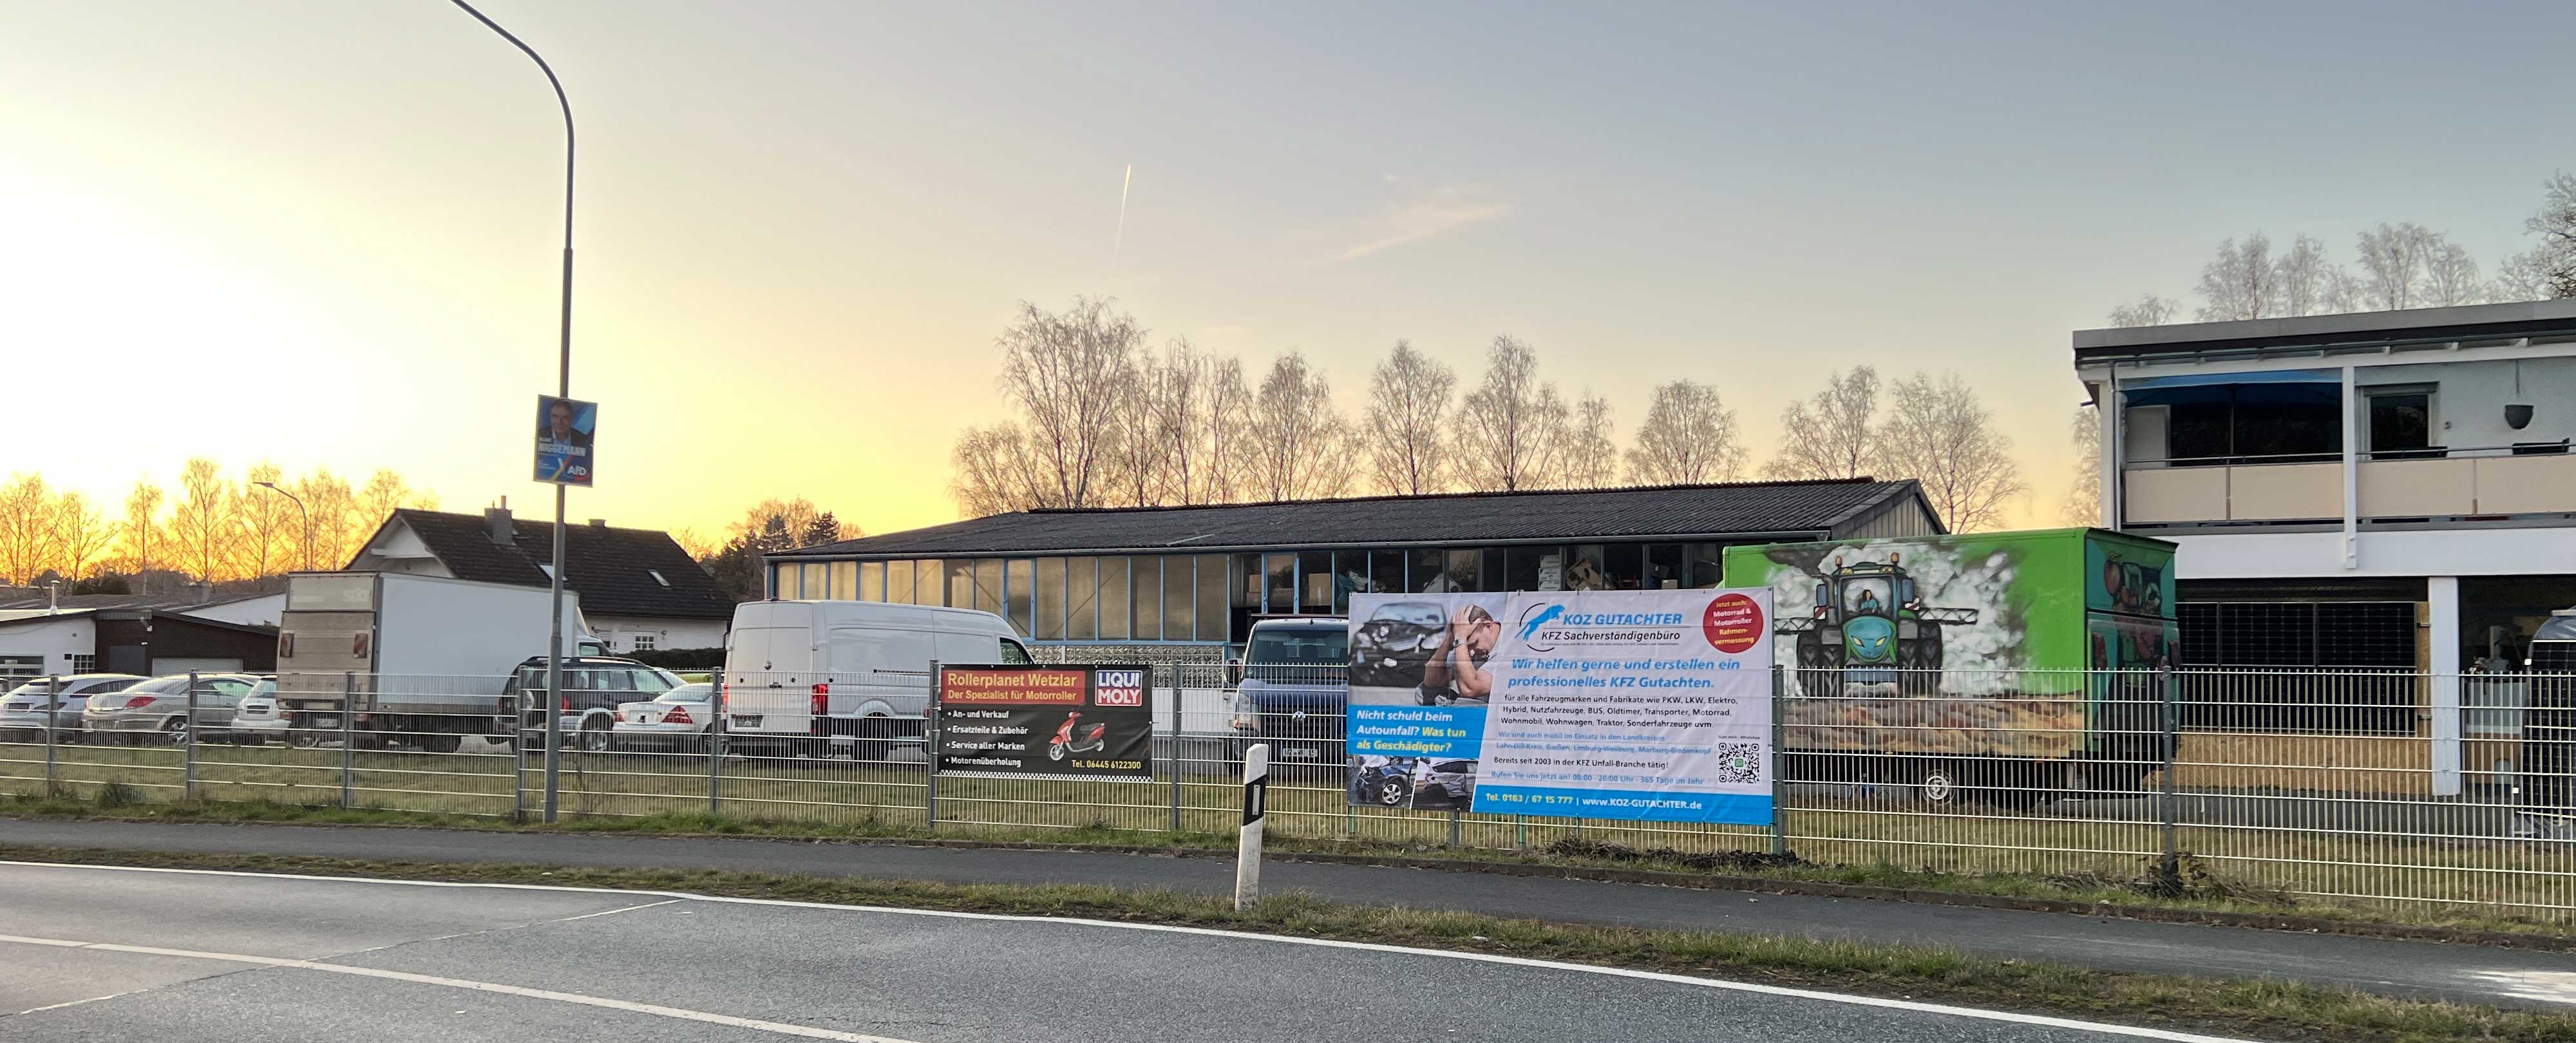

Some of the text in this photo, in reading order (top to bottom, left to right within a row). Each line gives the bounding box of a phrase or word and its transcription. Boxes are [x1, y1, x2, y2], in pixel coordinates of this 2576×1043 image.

[1713, 608, 1745, 617] Motorrad
[1563, 614, 1682, 625] KOZ GUTACHTER
[1714, 618, 1752, 626] Motorroller
[1542, 630, 1680, 642] KFZ Sachverständigenbüro
[1714, 637, 1754, 645] vermessung
[1513, 659, 1740, 672] Wir helfen gerne und erstellen ein
[948, 673, 1077, 689] Rollerplanet Wetzlar
[1097, 672, 1140, 688] LIQUI
[1508, 676, 1714, 688] professionelles KFZ Gutachten.
[948, 690, 1077, 701] Der Spezialist für Motorroller
[1097, 689, 1141, 704] MOLY
[1531, 695, 1591, 704] Fahrzeugmarken
[1708, 697, 1738, 705] Elektro,
[952, 710, 1009, 719] An- und Verkauf
[1356, 709, 1453, 722] Nicht schuld beim
[1531, 707, 1586, 715] Nutzfahrzeuge,
[1645, 708, 1690, 717] Transporter,
[1501, 717, 1544, 726] Wohnmobil,
[1546, 719, 1595, 727] Wohnwagen,
[1627, 720, 1692, 729] Sonderfahrzeuge
[952, 725, 1029, 735] Ersatzteile & Zubehör
[1356, 725, 1466, 737] Autounfall? Was tun
[951, 741, 1025, 751] Service aller Marken
[1356, 739, 1452, 753] als Geschädigter?
[1638, 746, 1711, 755] Marburg-Biedenkopf
[951, 756, 1021, 768] Motorenüberholung
[1072, 760, 1141, 769] Tel. 06445 6122300
[1592, 759, 1646, 768] Unfall-Branche
[1648, 761, 1669, 770] tätig!
[1656, 776, 1673, 785] Tage
[1486, 793, 1500, 802] Tel.
[1502, 794, 1524, 802] 0163
[1531, 795, 1542, 803] 67
[1557, 796, 1574, 804] 777
[1582, 798, 1702, 810] www.KOZ-GUTACHTER.de
